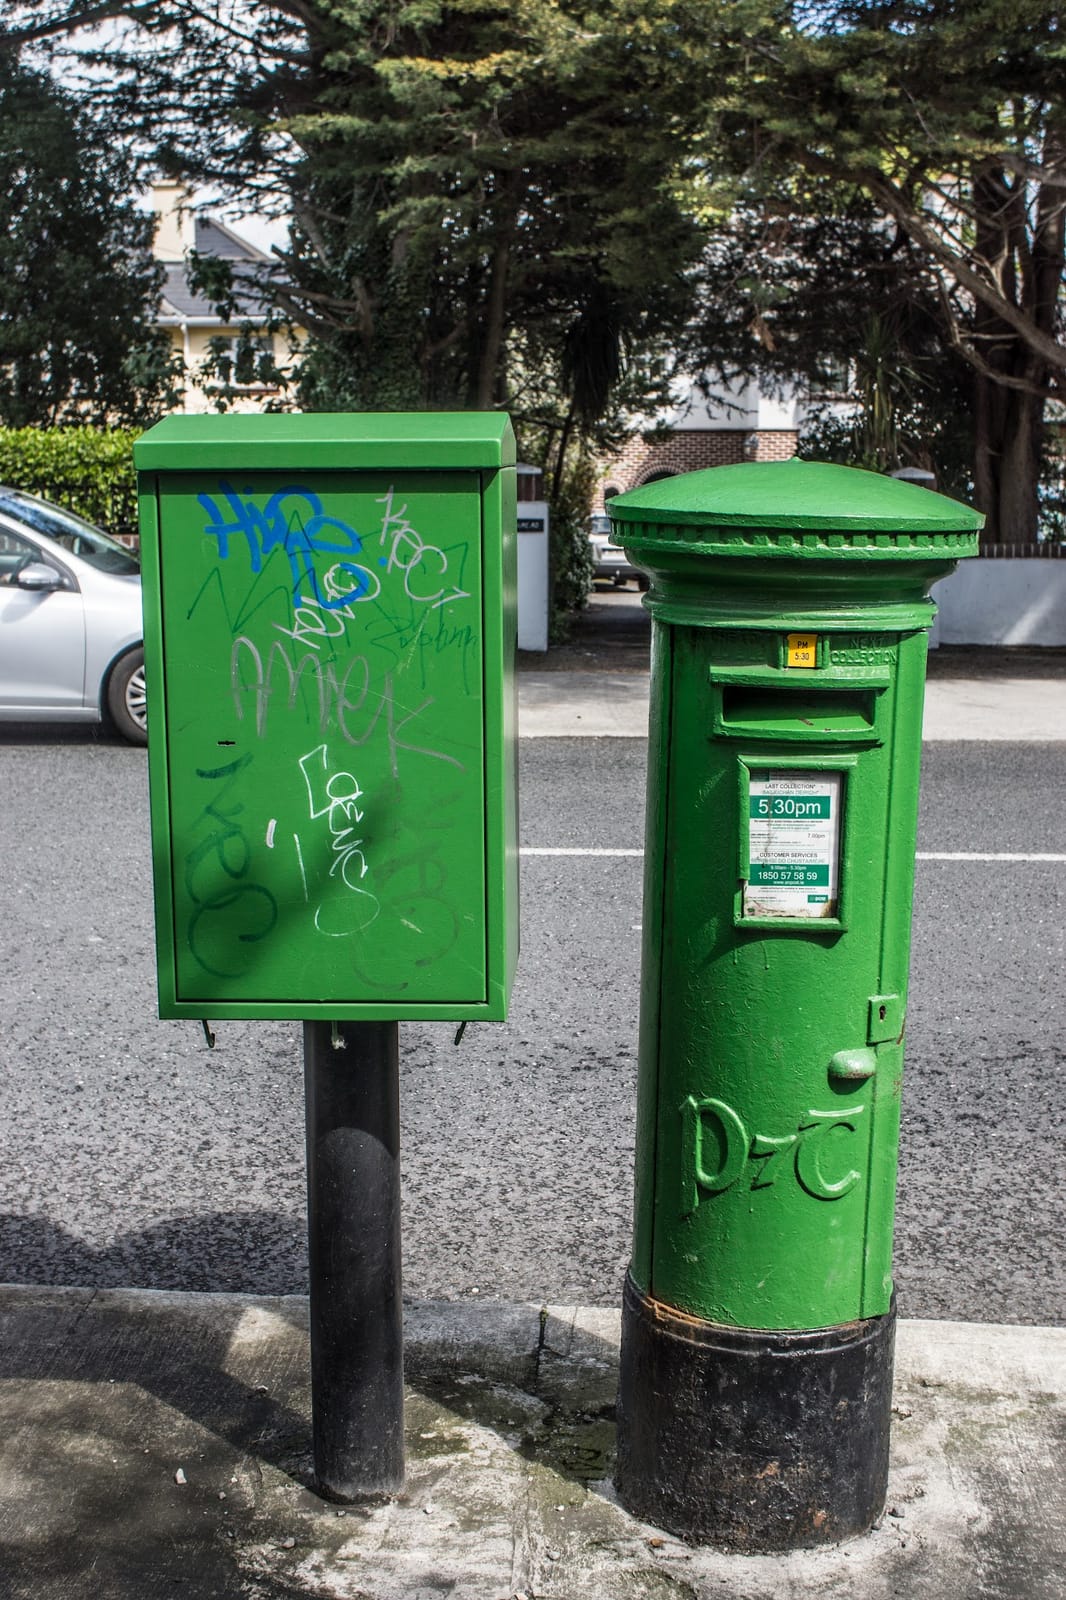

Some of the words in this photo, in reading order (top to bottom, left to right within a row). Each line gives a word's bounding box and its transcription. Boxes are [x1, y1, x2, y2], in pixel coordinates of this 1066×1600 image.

[758, 799, 821, 818] 5.30pm
[758, 872, 779, 880] 1850
[781, 872, 792, 880] 57
[793, 872, 805, 880] 58
[806, 872, 818, 880] 59
